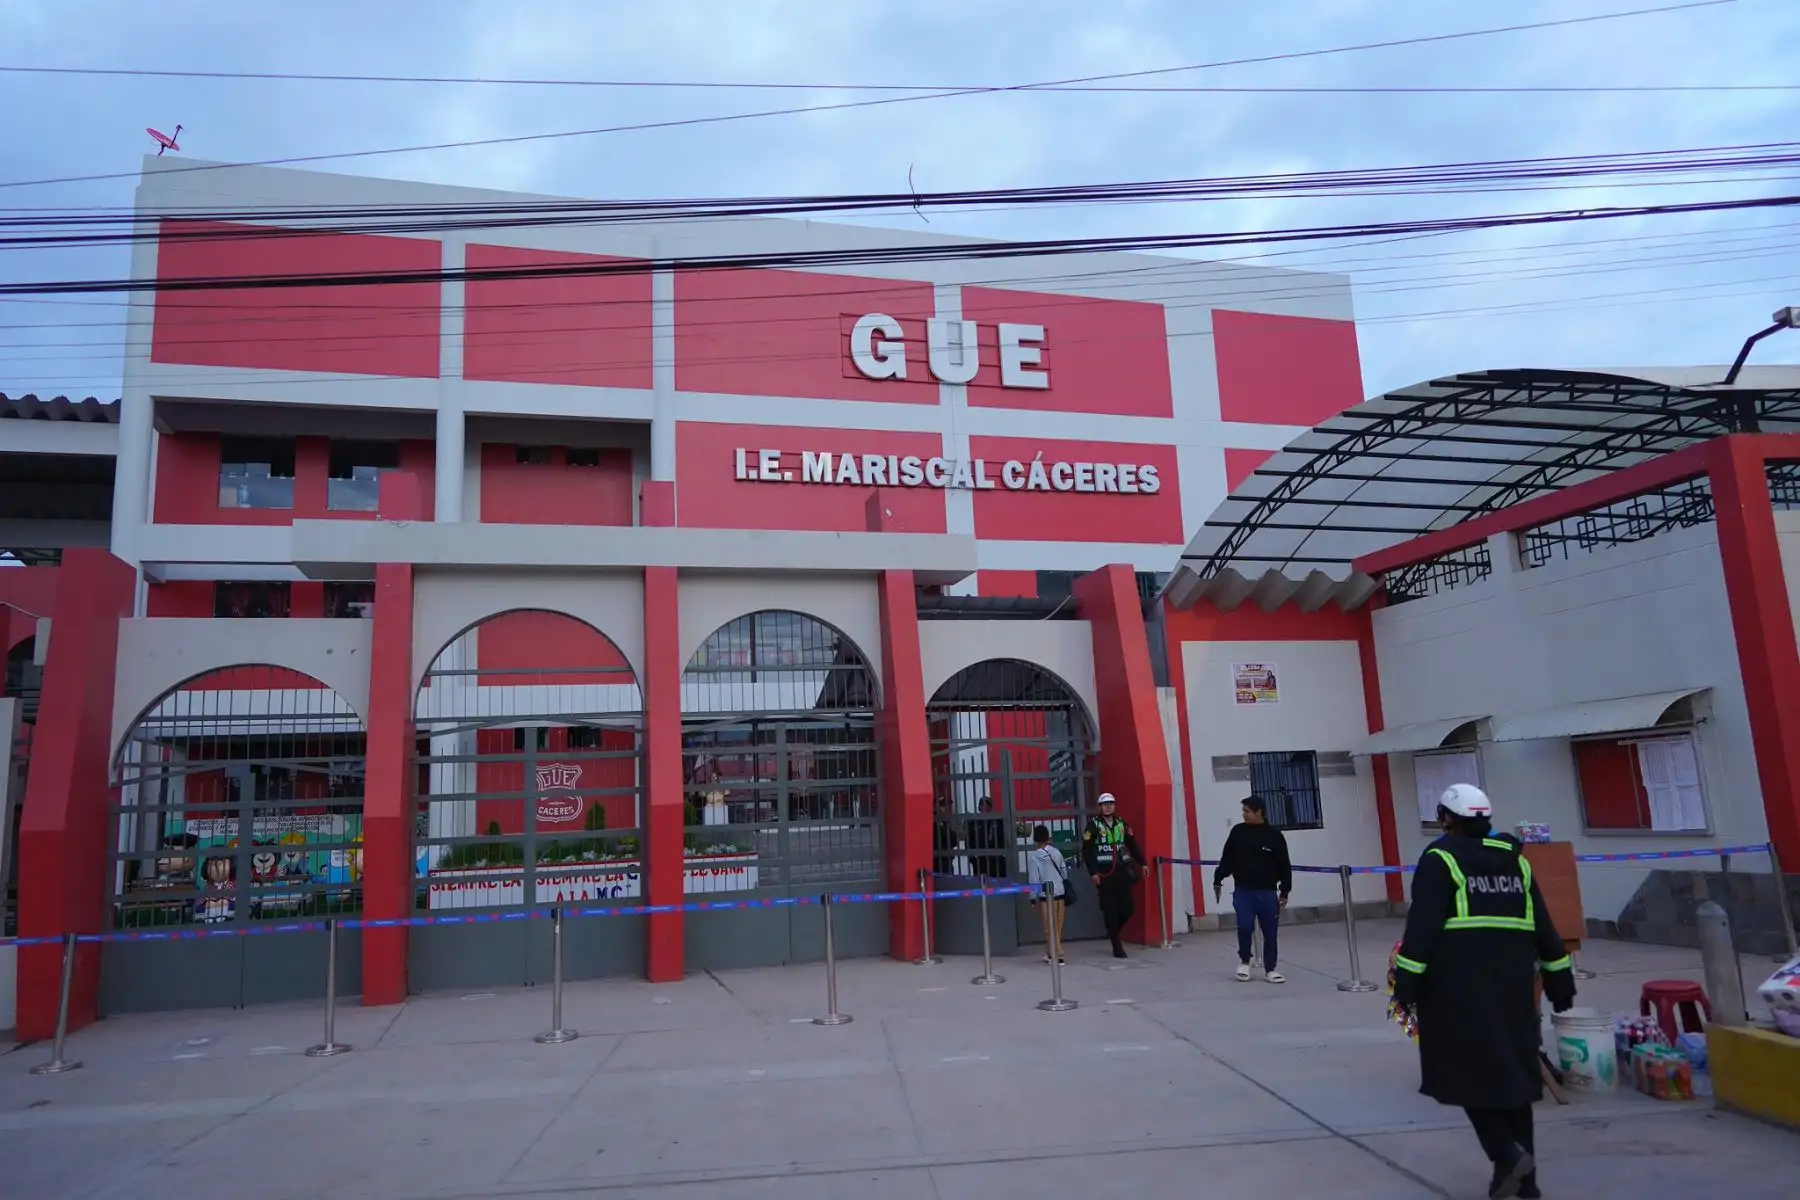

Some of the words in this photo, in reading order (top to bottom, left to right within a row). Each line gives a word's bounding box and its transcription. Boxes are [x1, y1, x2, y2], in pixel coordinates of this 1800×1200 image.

[850, 313, 1049, 390] GUE
[735, 447, 793, 482] I.E.
[802, 450, 994, 490] MARISCAL
[1003, 450, 1161, 495] CÁCERES
[538, 769, 576, 787] GUE
[538, 806, 575, 816] CACERES
[1467, 875, 1524, 894] POLICIA
